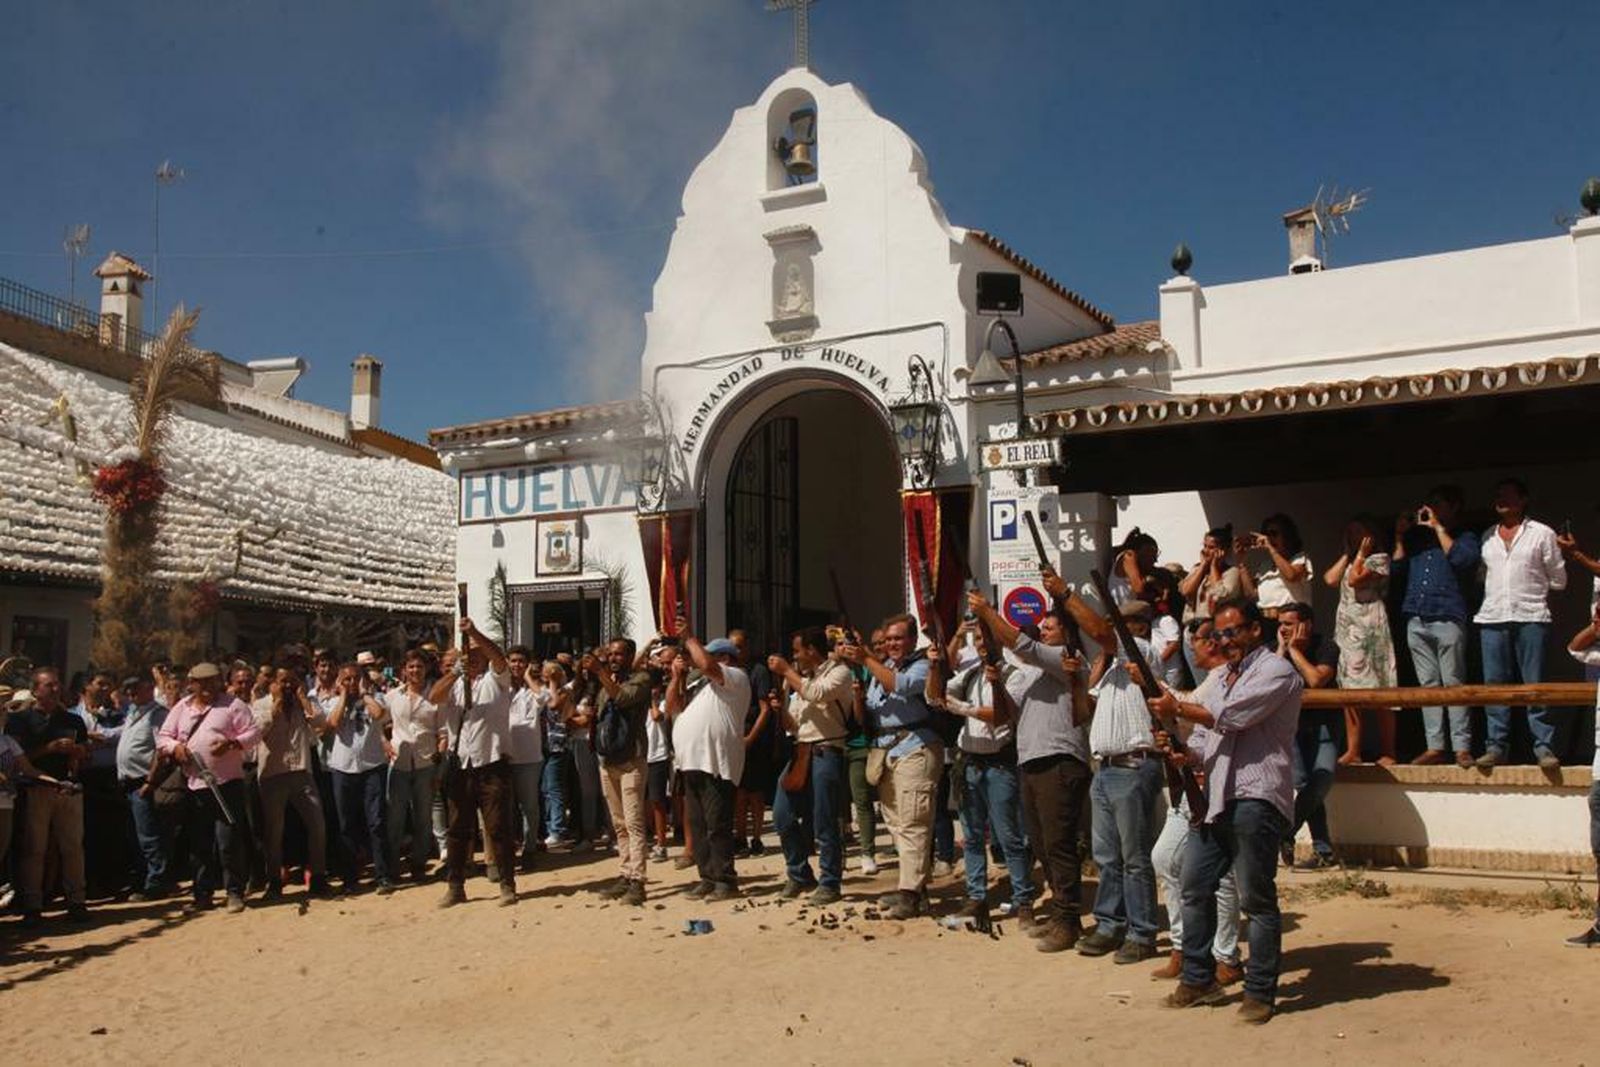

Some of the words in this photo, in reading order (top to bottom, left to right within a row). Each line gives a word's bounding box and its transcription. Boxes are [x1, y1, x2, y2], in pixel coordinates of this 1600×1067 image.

[682, 356, 763, 453] HERMANDAD
[780, 349, 804, 361] DE
[821, 348, 889, 394] HUELVA
[1007, 446, 1020, 463] EL
[1024, 442, 1054, 461] REAL
[464, 464, 638, 519] HUELVA
[993, 504, 1015, 538] P
